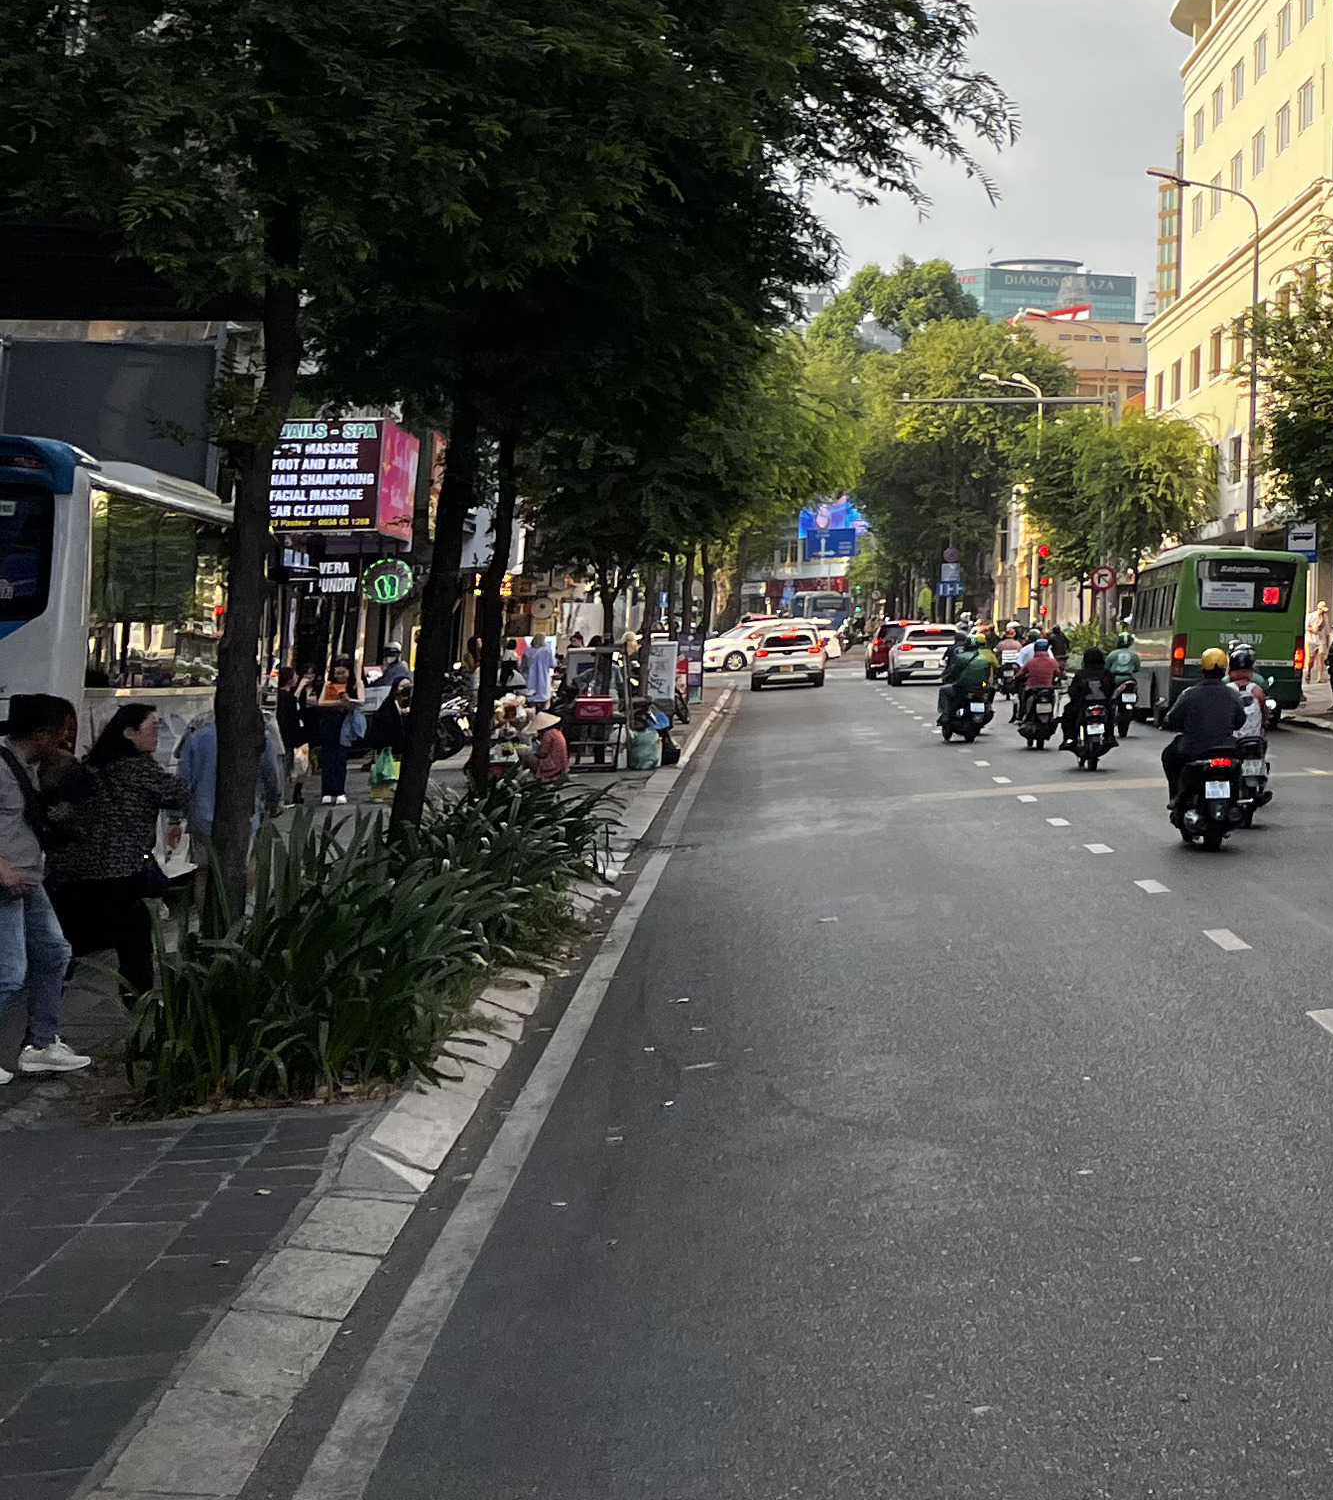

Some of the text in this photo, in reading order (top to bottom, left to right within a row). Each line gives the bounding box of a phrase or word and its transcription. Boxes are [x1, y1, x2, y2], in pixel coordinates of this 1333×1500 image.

[1004, 274, 1064, 287] DIAMON
[342, 423, 378, 439] SPA
[305, 443, 360, 455] MASSAGE
[272, 458, 359, 471] FOOT AND BACK
[270, 473, 375, 486] HAIR SHAMPOOING
[269, 488, 364, 501] FACIAL MASSAGE
[293, 504, 350, 517] CLEANING
